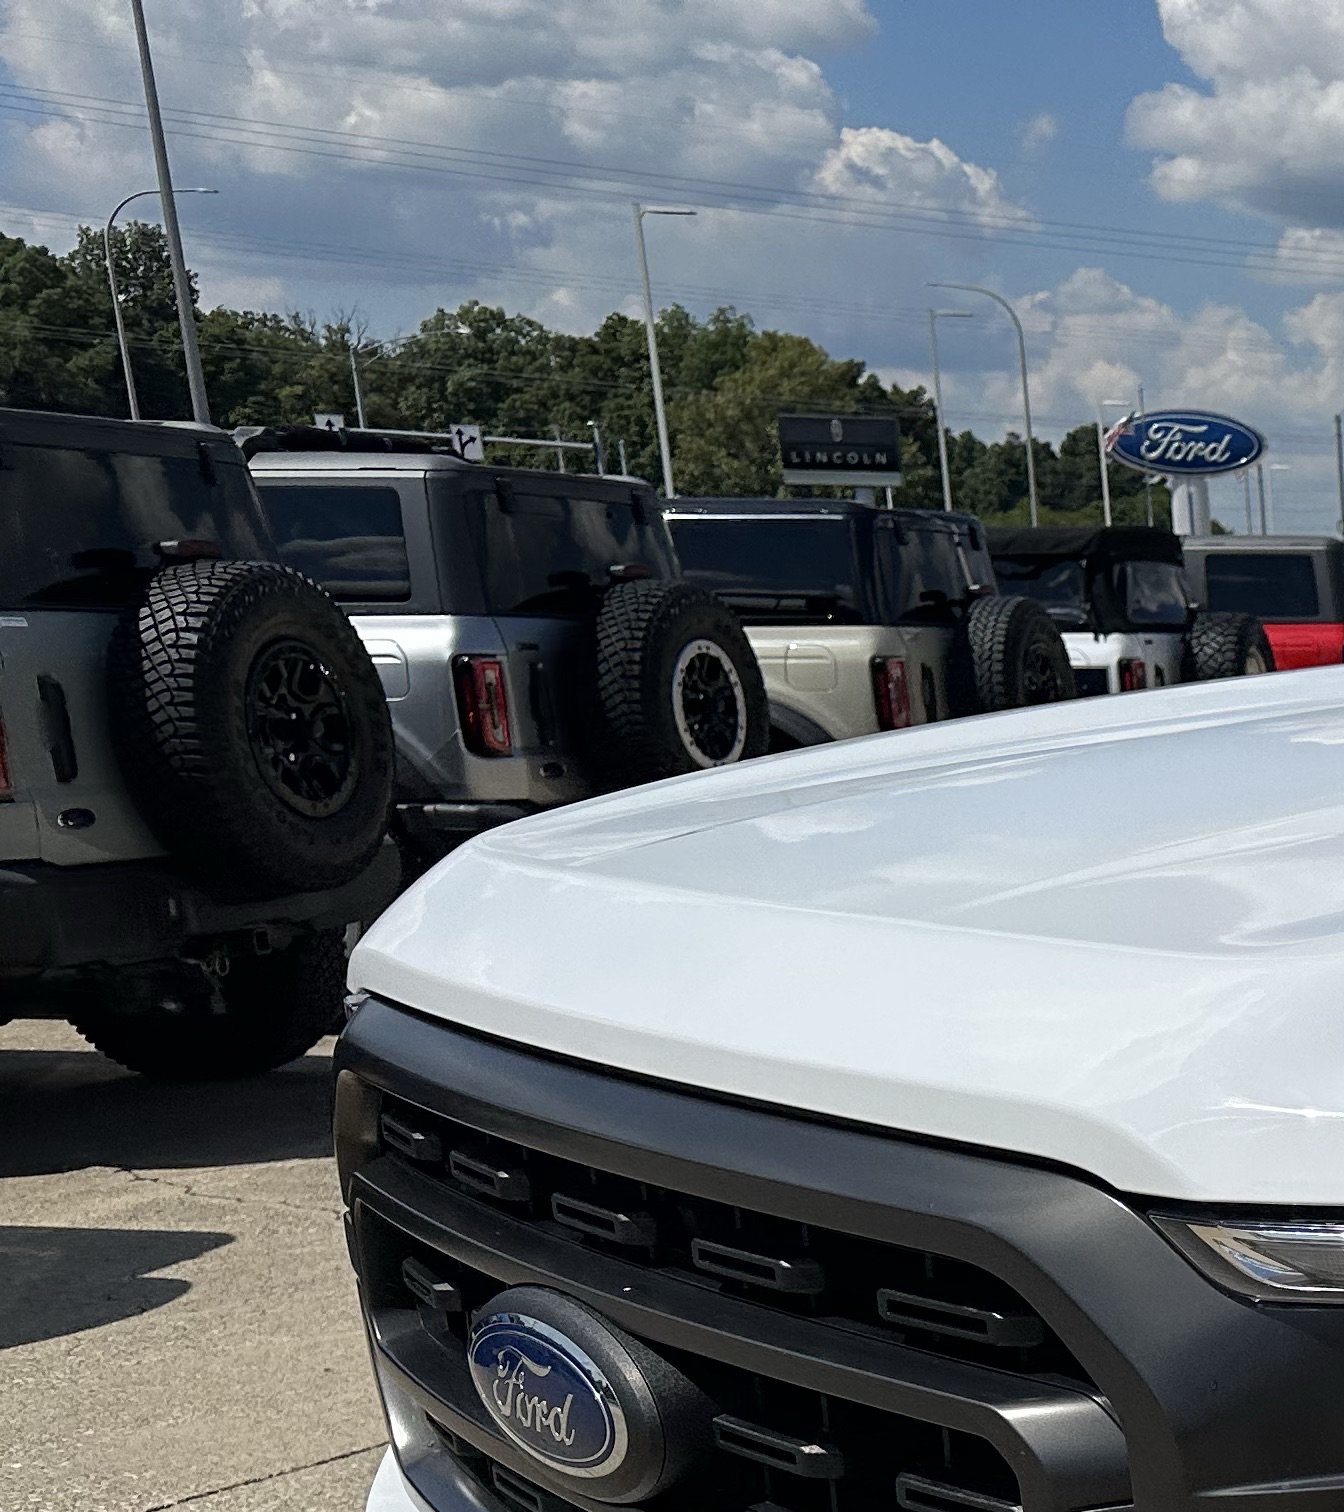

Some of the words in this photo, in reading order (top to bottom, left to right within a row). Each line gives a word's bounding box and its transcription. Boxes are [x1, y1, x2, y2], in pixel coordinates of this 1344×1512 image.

[790, 451, 887, 465] LINCOLN
[1140, 421, 1232, 462] Ford
[493, 1345, 576, 1446] Ford
